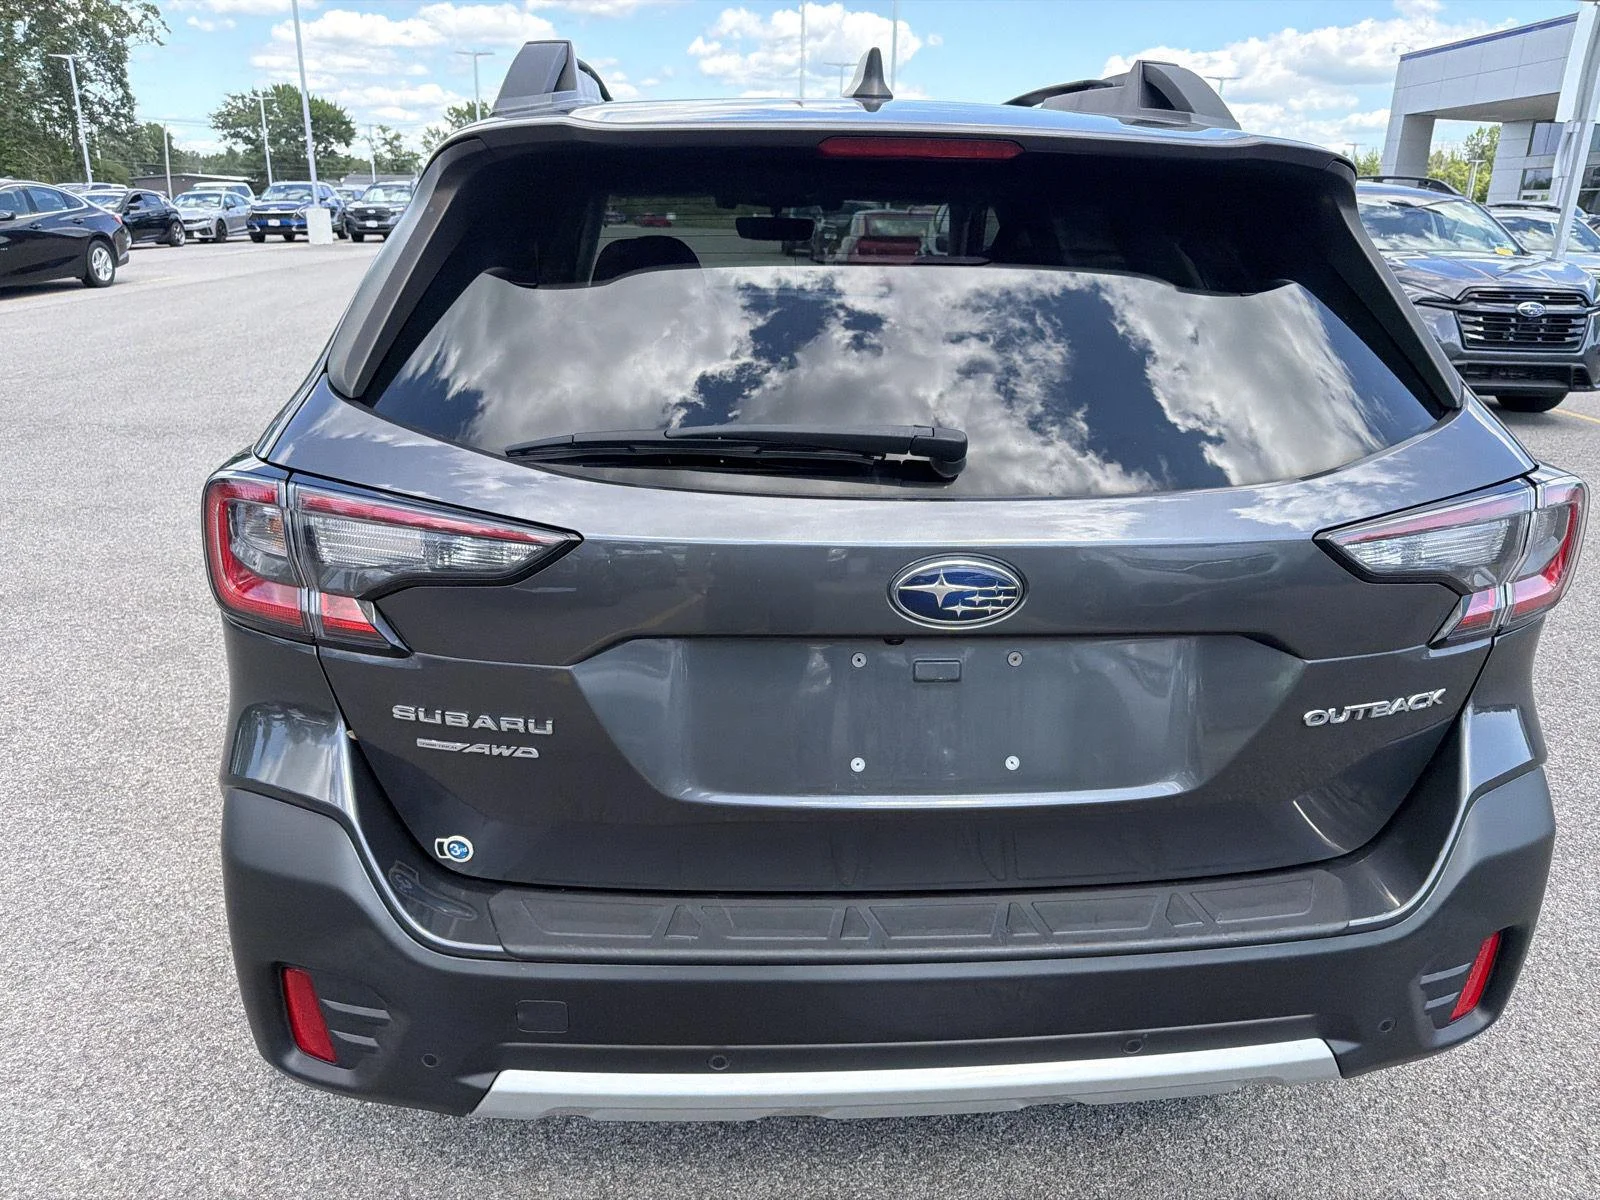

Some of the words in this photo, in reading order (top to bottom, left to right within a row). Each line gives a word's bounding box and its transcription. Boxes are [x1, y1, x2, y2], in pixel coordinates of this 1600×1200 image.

[391, 704, 553, 735] SUBARU
[1303, 688, 1446, 727] OUTBACK
[462, 743, 539, 758] AWD
